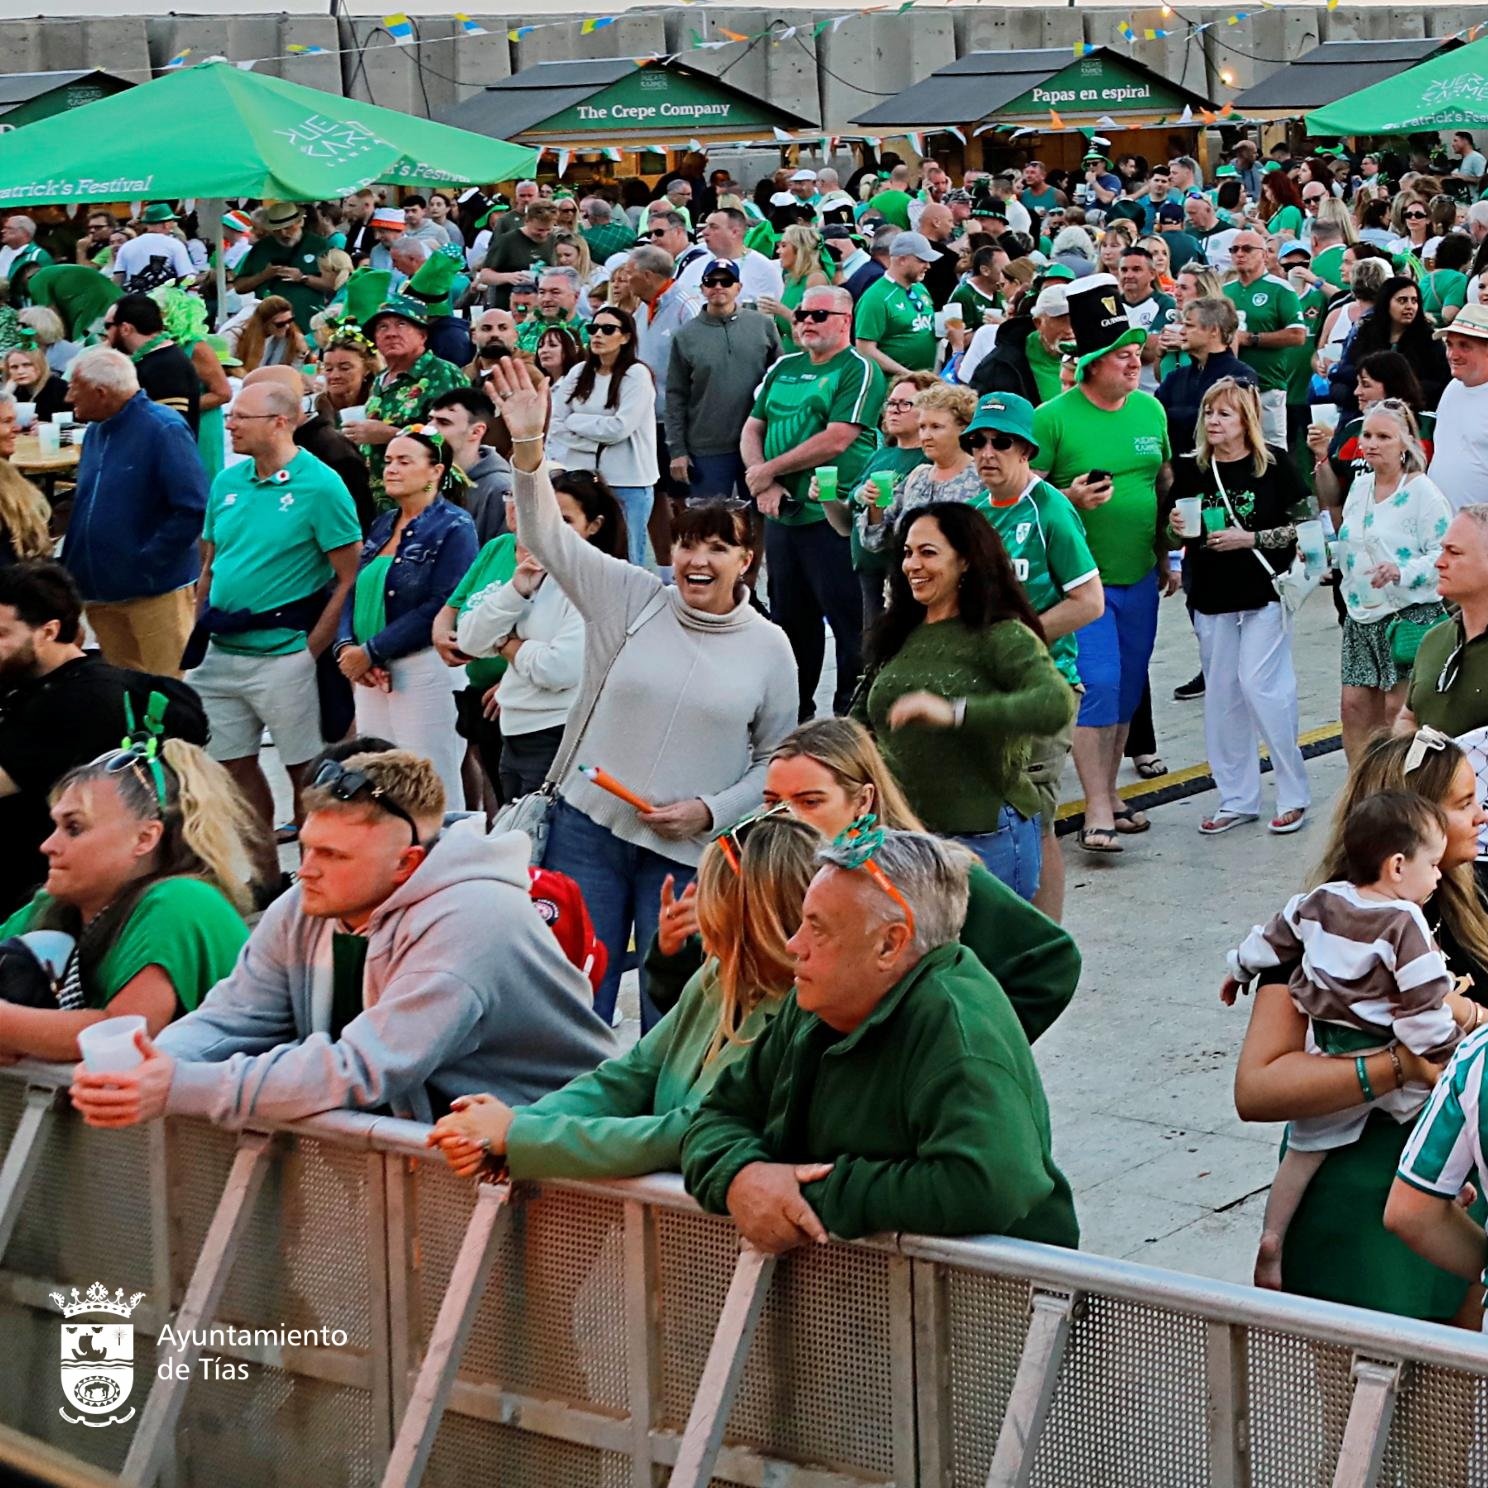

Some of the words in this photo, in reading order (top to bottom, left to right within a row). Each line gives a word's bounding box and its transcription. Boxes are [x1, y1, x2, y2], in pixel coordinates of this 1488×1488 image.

[1032, 88, 1076, 105] Papas
[1080, 89, 1098, 100] en
[1102, 84, 1150, 102] espiral
[577, 106, 607, 119] The
[611, 105, 656, 120] Crepe
[660, 103, 730, 117] Company
[0, 179, 73, 199] atrick's
[75, 175, 154, 195] Festival
[912, 313, 933, 332] sky
